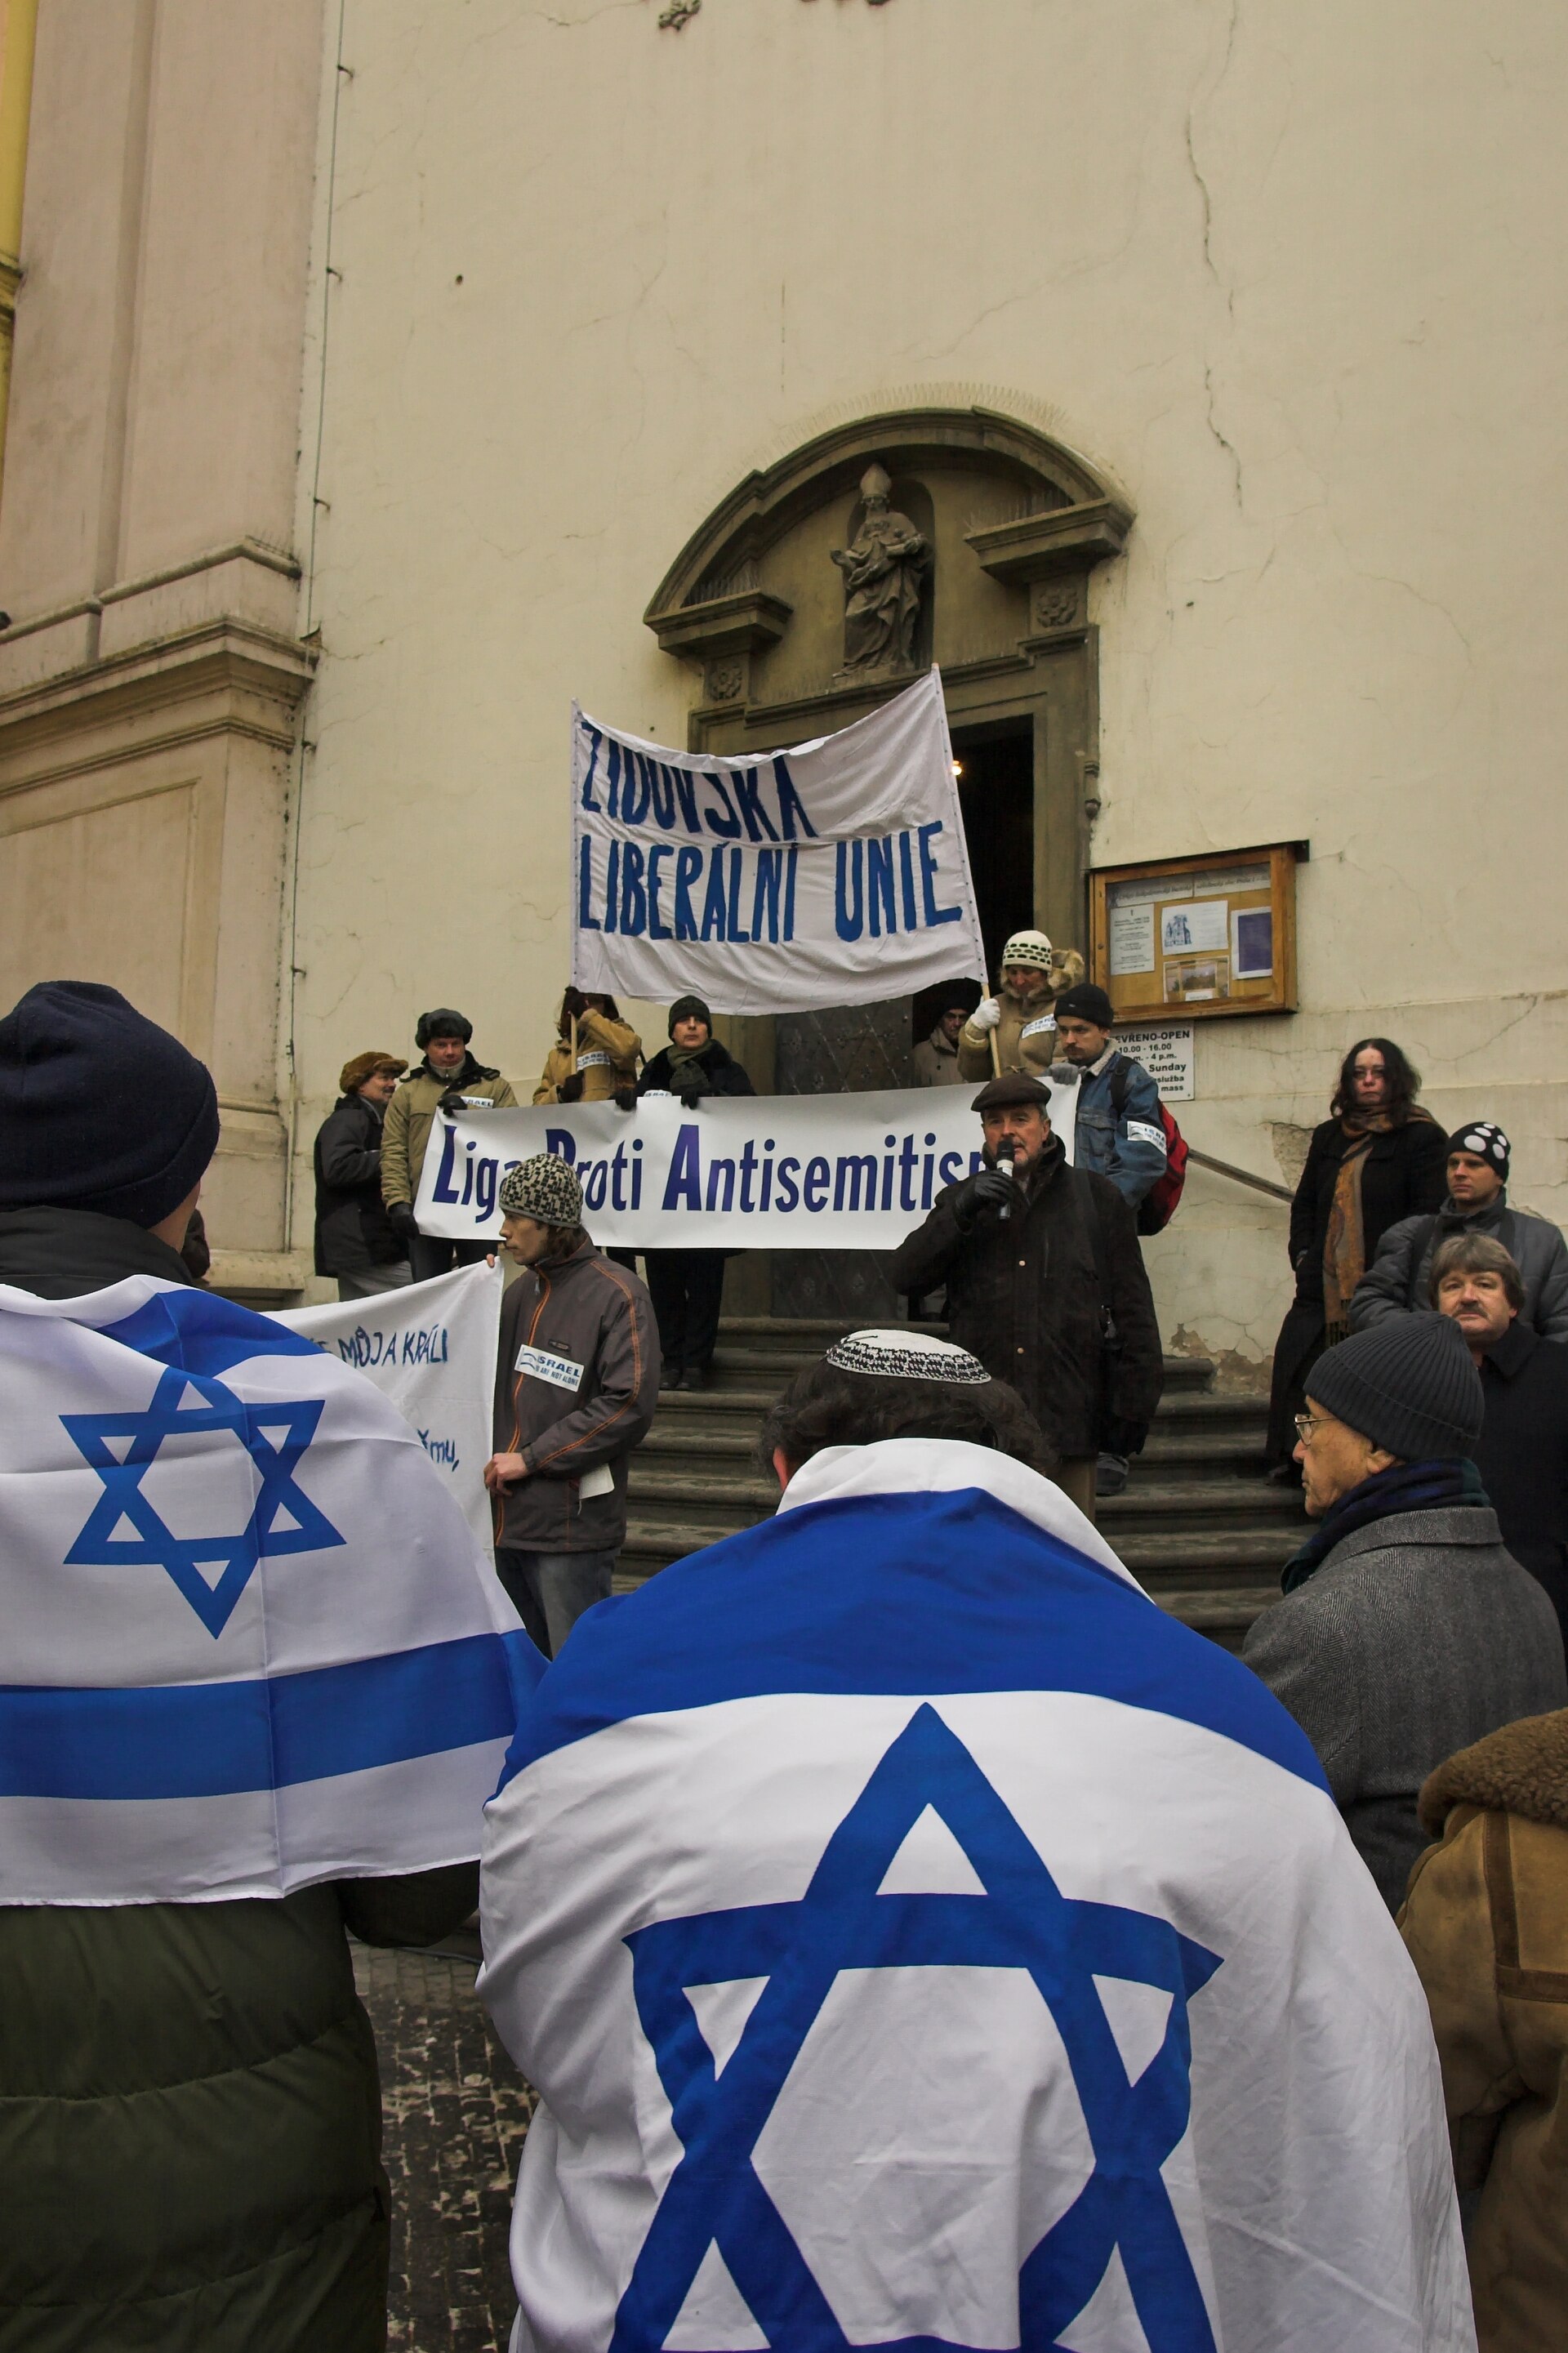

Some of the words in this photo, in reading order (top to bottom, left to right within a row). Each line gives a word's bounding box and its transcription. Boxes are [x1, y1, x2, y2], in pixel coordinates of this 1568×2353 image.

[835, 820, 963, 942] UNIE
[1112, 1030, 1190, 1043] EVŘENO-OPEN
[1149, 1044, 1172, 1052] 16.00
[1149, 1063, 1187, 1072] Sunday
[1156, 1076, 1184, 1084] služba
